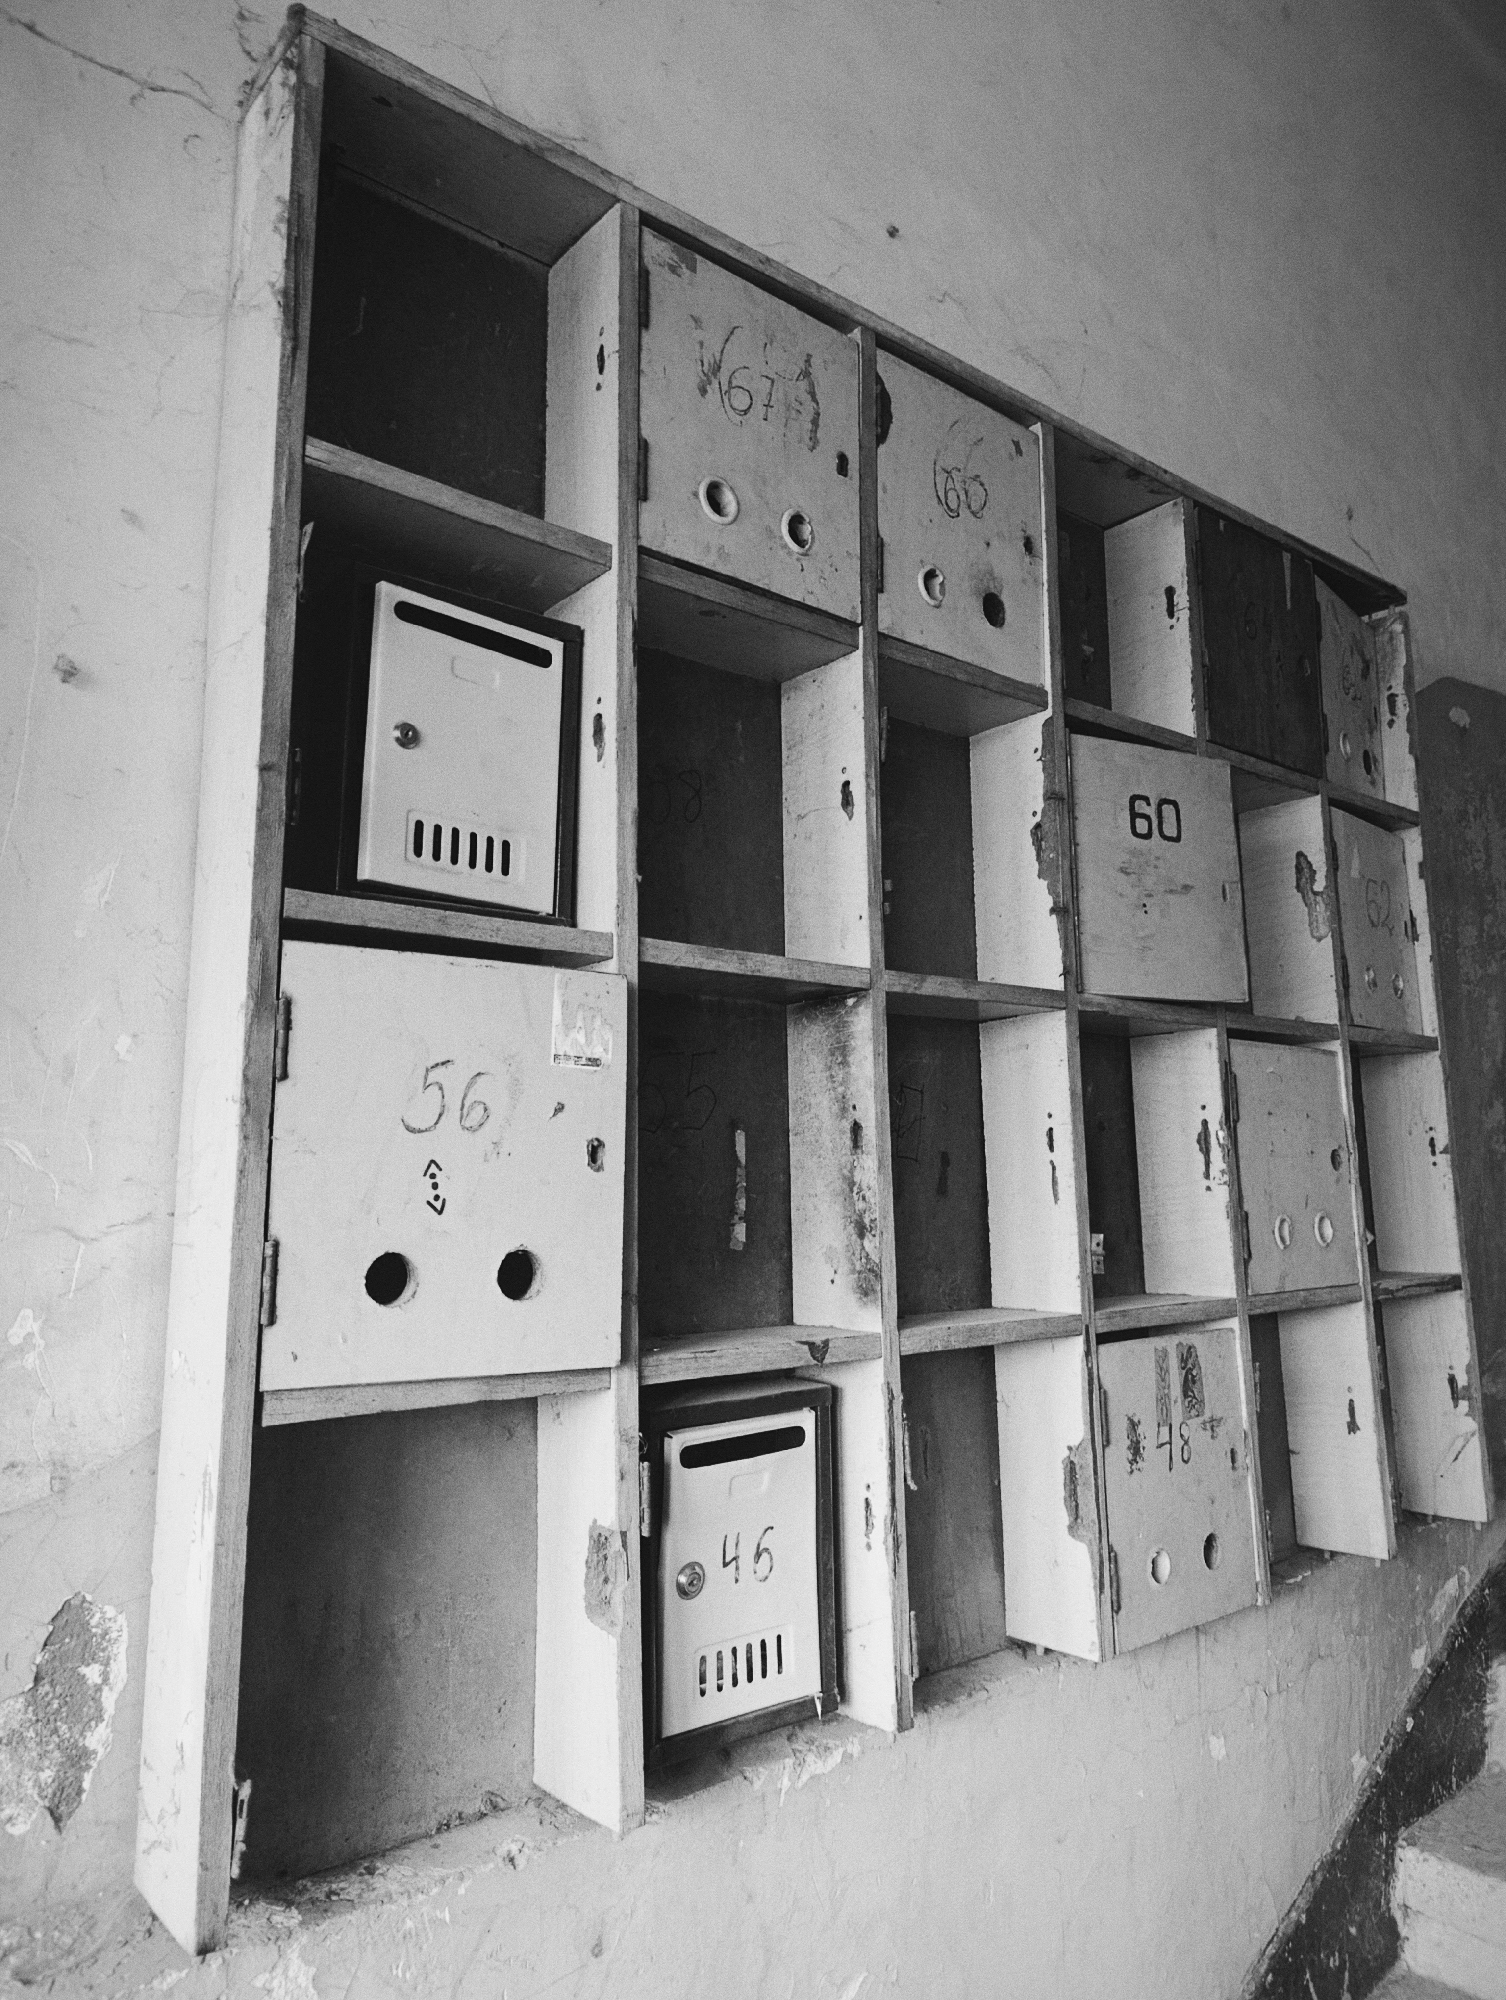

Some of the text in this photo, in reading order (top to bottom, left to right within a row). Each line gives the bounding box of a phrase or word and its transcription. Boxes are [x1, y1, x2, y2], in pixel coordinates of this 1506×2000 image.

[1129, 794, 1181, 843] 60
[401, 1058, 492, 1134] 56
[1156, 1421, 1192, 1472] 48
[722, 1525, 774, 1585] 46
